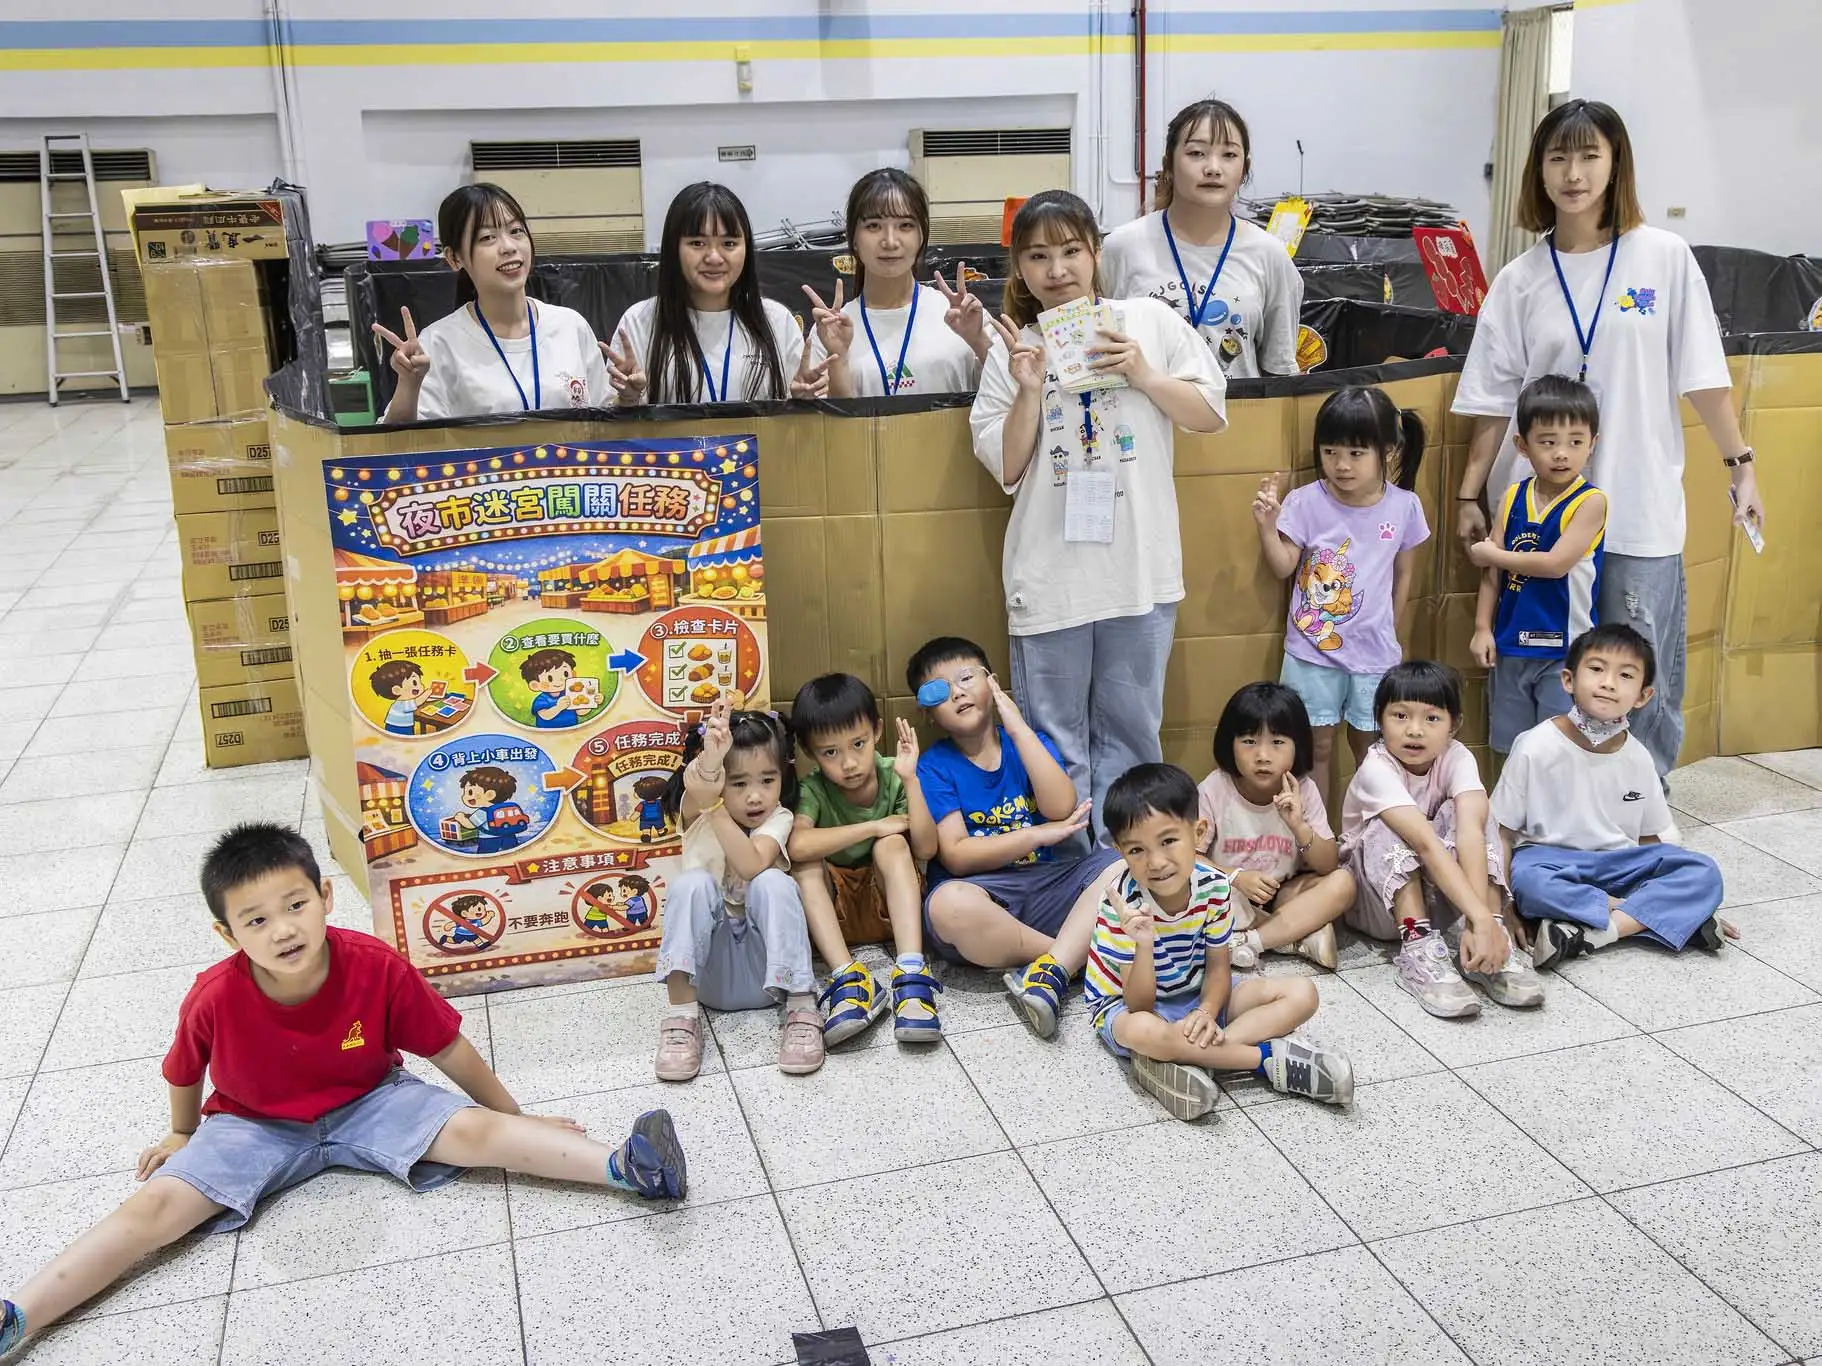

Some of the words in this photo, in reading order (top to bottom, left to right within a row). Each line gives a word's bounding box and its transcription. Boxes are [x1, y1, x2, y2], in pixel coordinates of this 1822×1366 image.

[398, 484, 692, 538] 夜市迷宮闖關任務
[261, 533, 280, 544] D25
[272, 619, 289, 630] D25
[674, 619, 738, 635] 檢查卡片
[521, 633, 600, 650] 查看要買什麼
[378, 645, 457, 661] 抽一張任務卡
[217, 734, 241, 746] D257
[451, 747, 538, 766] 背上小車出發
[614, 753, 678, 773] 任務完成!
[543, 854, 615, 874] 注意事項
[508, 911, 570, 930] 不要奔跑
